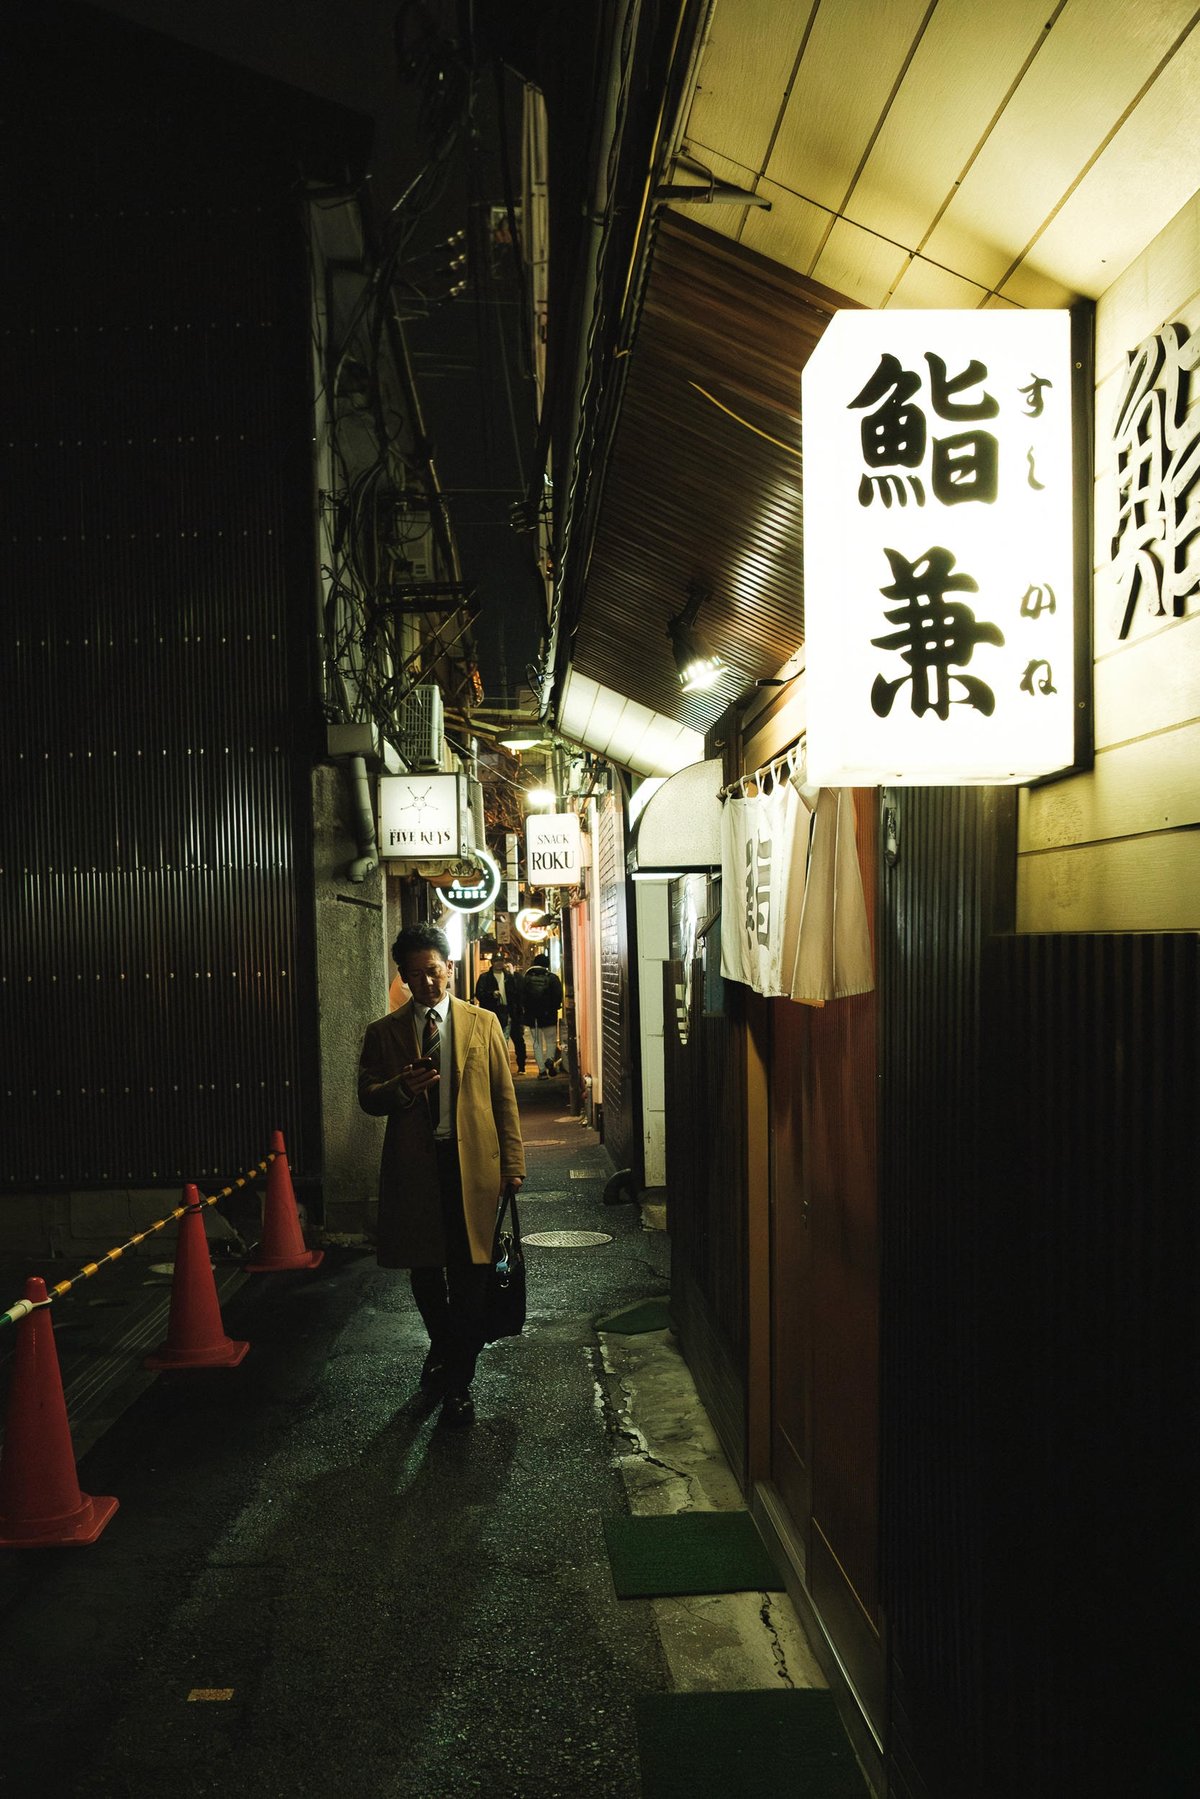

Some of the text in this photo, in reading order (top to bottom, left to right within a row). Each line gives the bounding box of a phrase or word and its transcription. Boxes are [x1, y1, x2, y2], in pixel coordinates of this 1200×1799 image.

[1017, 372, 1053, 491] すし
[847, 351, 1006, 721] 鮨兼
[389, 831, 451, 846] FIVE KEYS
[537, 834, 569, 845] SNACK
[532, 851, 575, 870] ROKU
